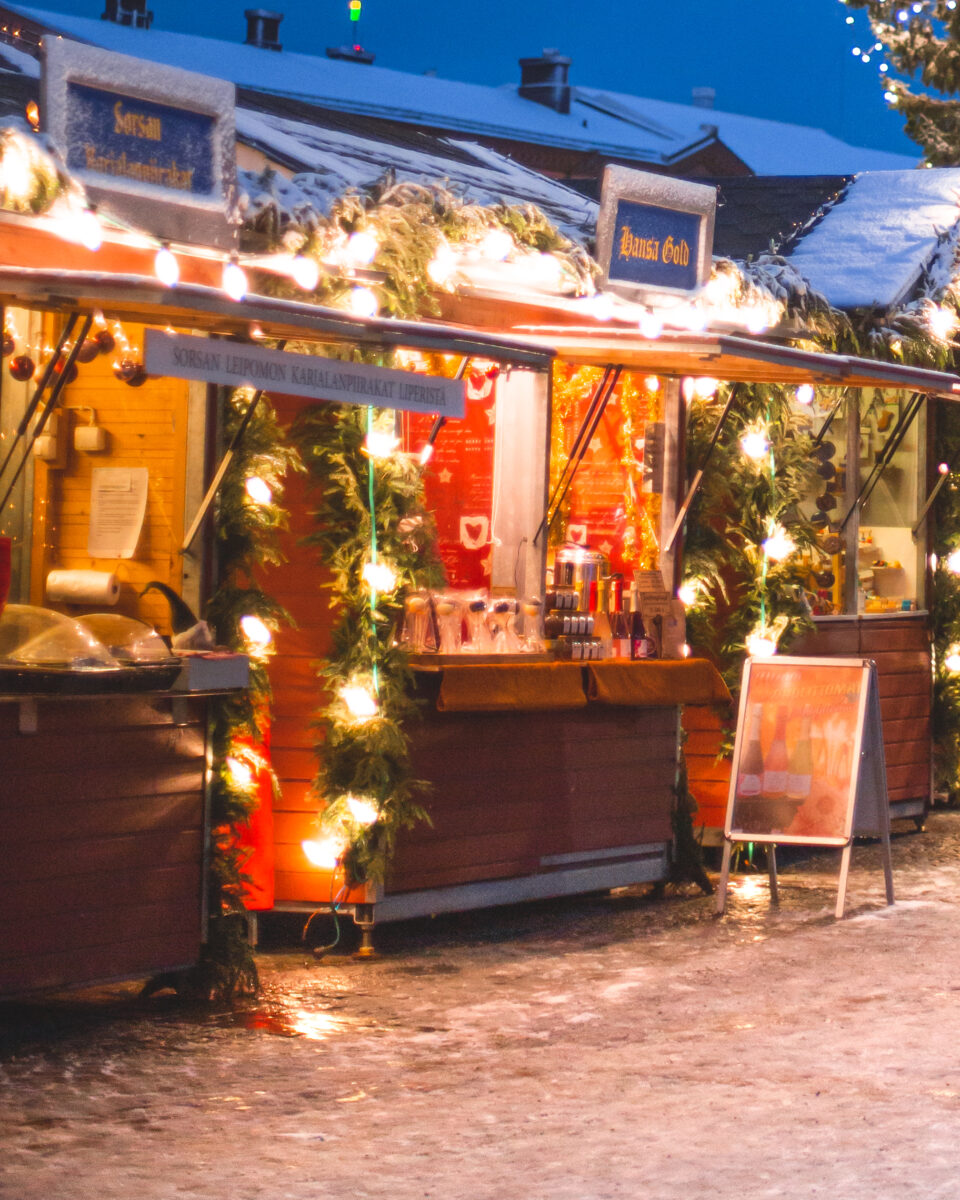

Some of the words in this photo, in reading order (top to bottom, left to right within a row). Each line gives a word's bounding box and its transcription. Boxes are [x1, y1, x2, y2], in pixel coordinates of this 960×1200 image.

[113, 101, 161, 141] Sorsan
[619, 226, 659, 261] Hansa
[662, 235, 690, 267] Gold
[172, 348, 221, 371] SORSAN
[225, 355, 287, 382] LEIPOMON
[290, 365, 394, 398] KARJALANPIIRAKAT
